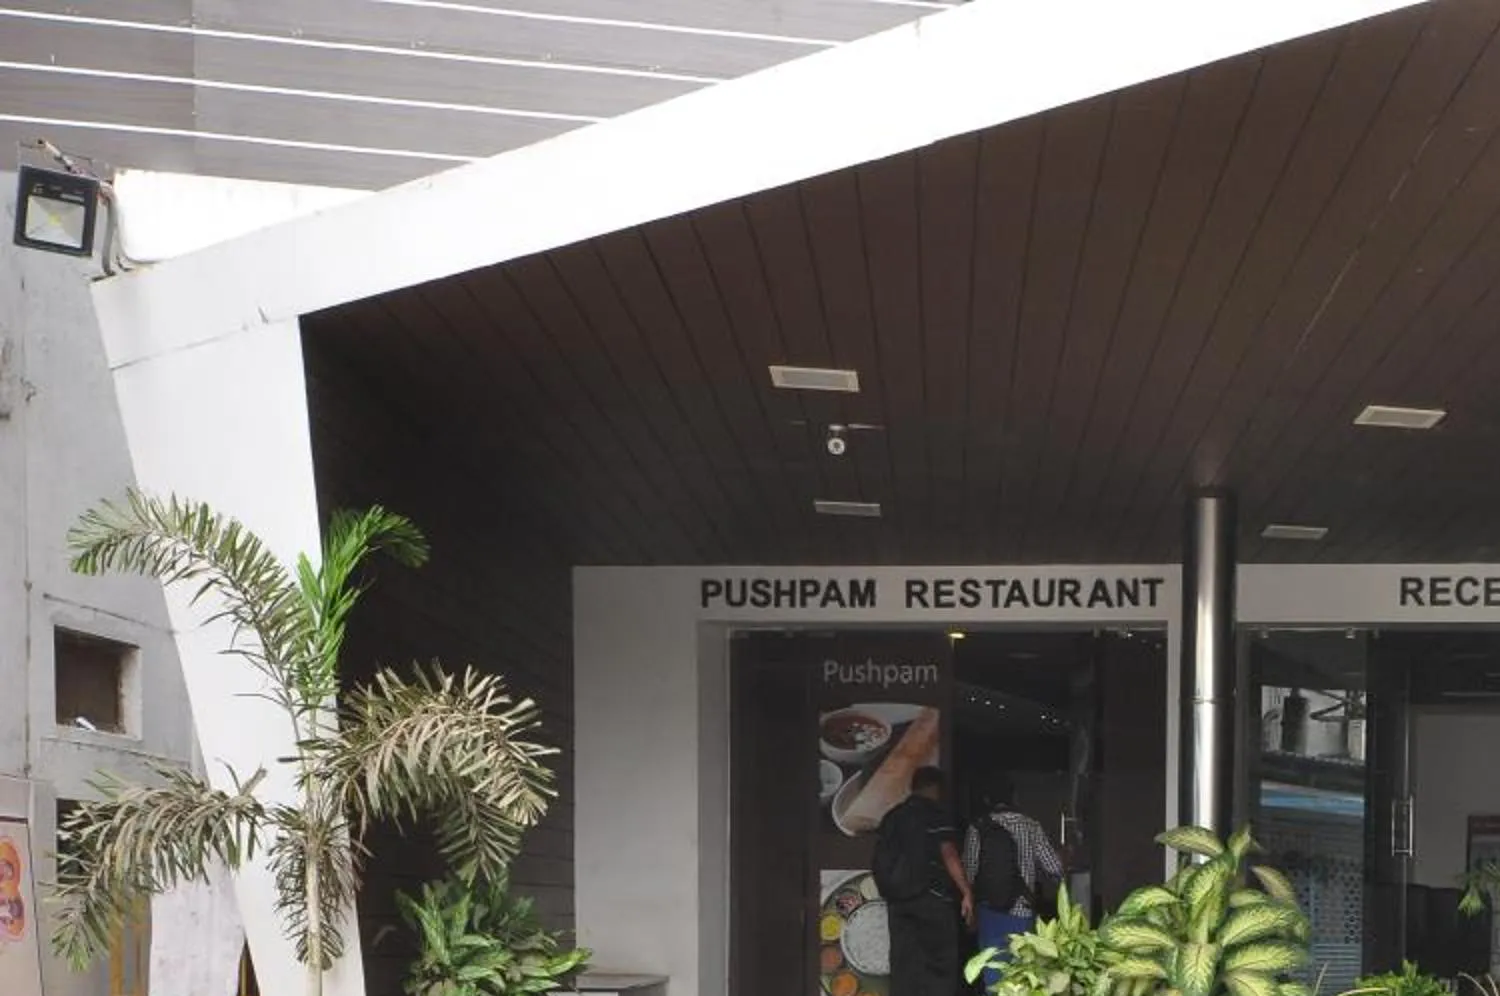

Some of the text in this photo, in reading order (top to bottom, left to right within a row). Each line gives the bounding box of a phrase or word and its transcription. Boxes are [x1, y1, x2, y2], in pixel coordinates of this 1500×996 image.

[701, 577, 1164, 608] PUSHPAM RESTAURANT
[823, 657, 938, 688] Pushpam
